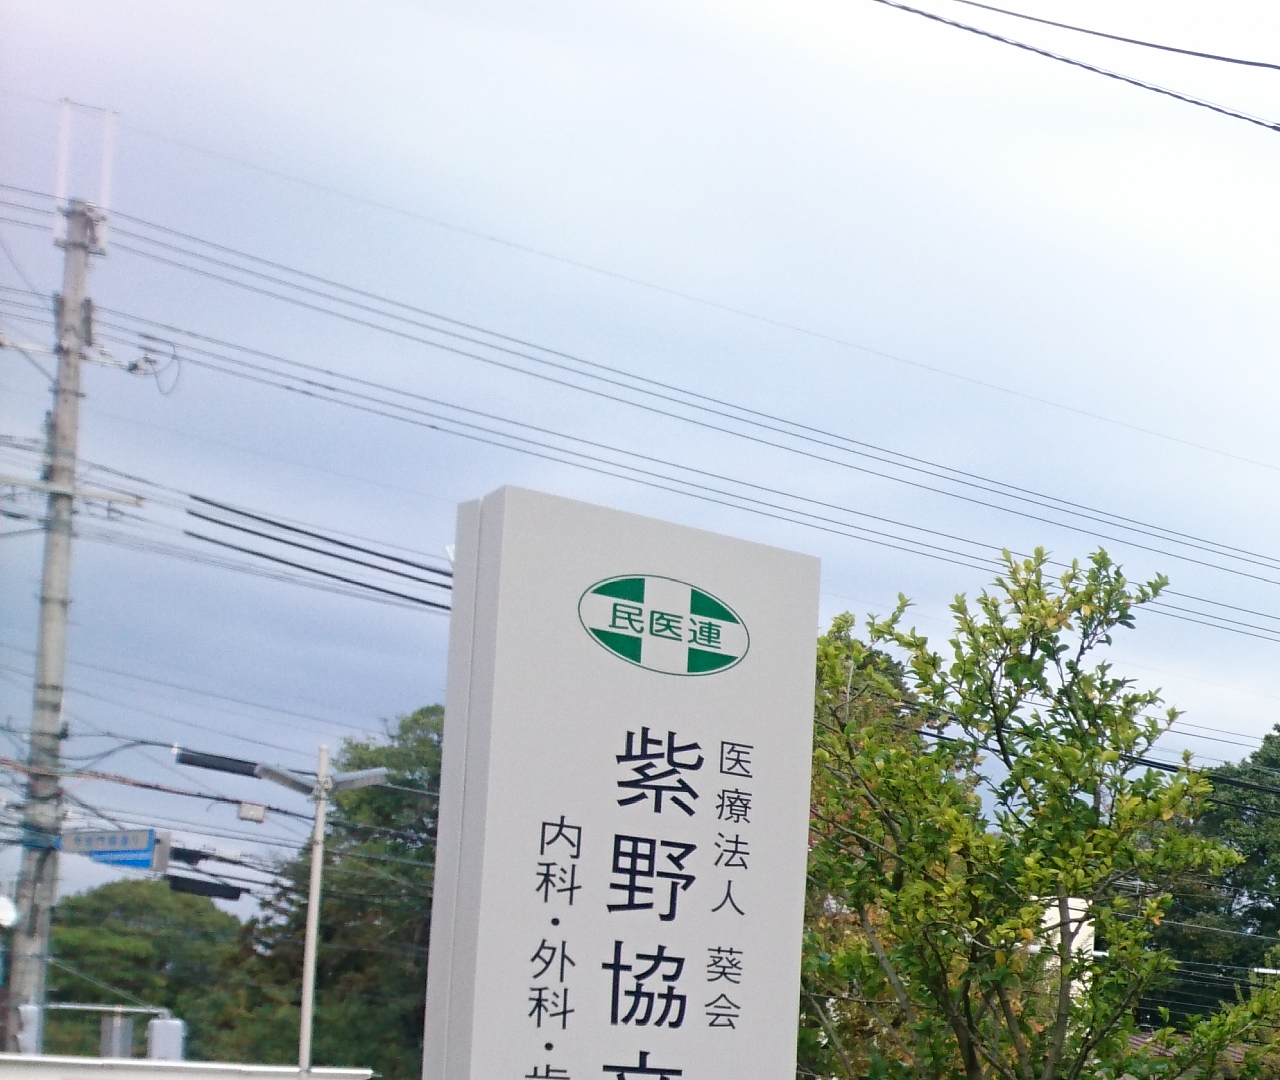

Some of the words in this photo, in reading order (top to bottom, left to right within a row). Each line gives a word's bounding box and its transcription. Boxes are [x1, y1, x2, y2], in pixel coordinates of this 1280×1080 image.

[608, 602, 723, 650] 民医連
[711, 740, 755, 917] 医療法人
[704, 946, 744, 1030] 葵会
